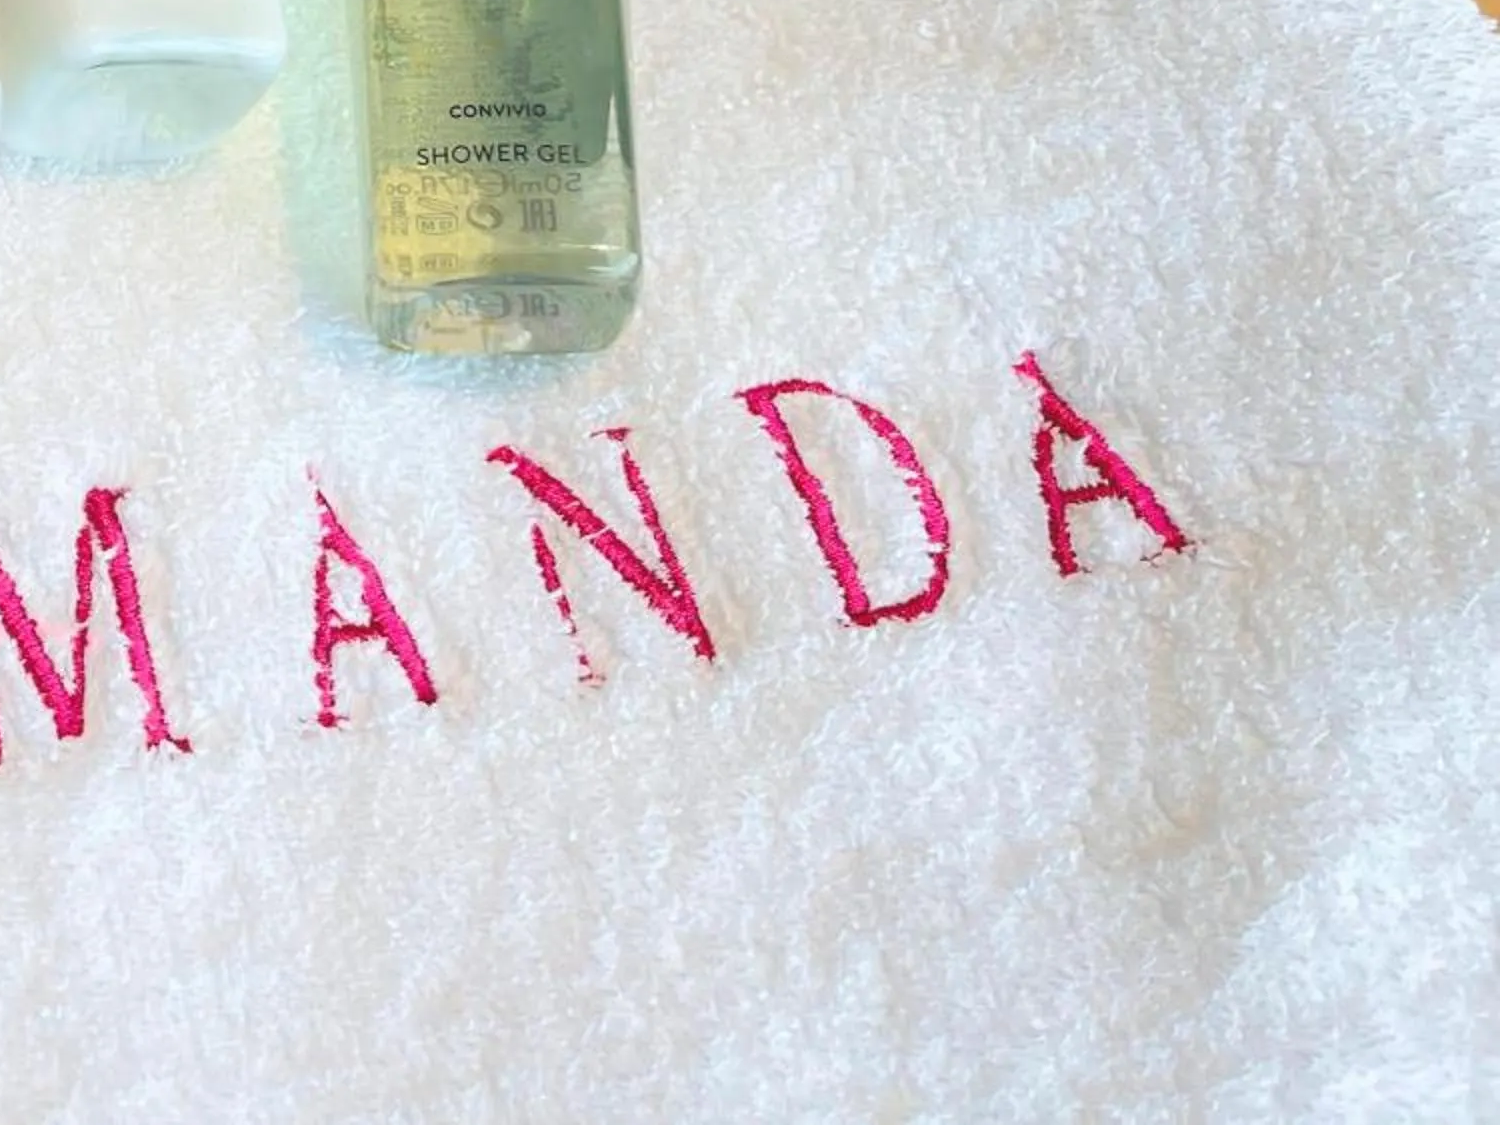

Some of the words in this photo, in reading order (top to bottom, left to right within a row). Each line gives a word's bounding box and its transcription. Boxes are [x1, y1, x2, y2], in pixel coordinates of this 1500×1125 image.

[449, 104, 547, 119] CONVIVIO
[416, 143, 530, 166] SHOWER
[536, 144, 587, 165] GEL
